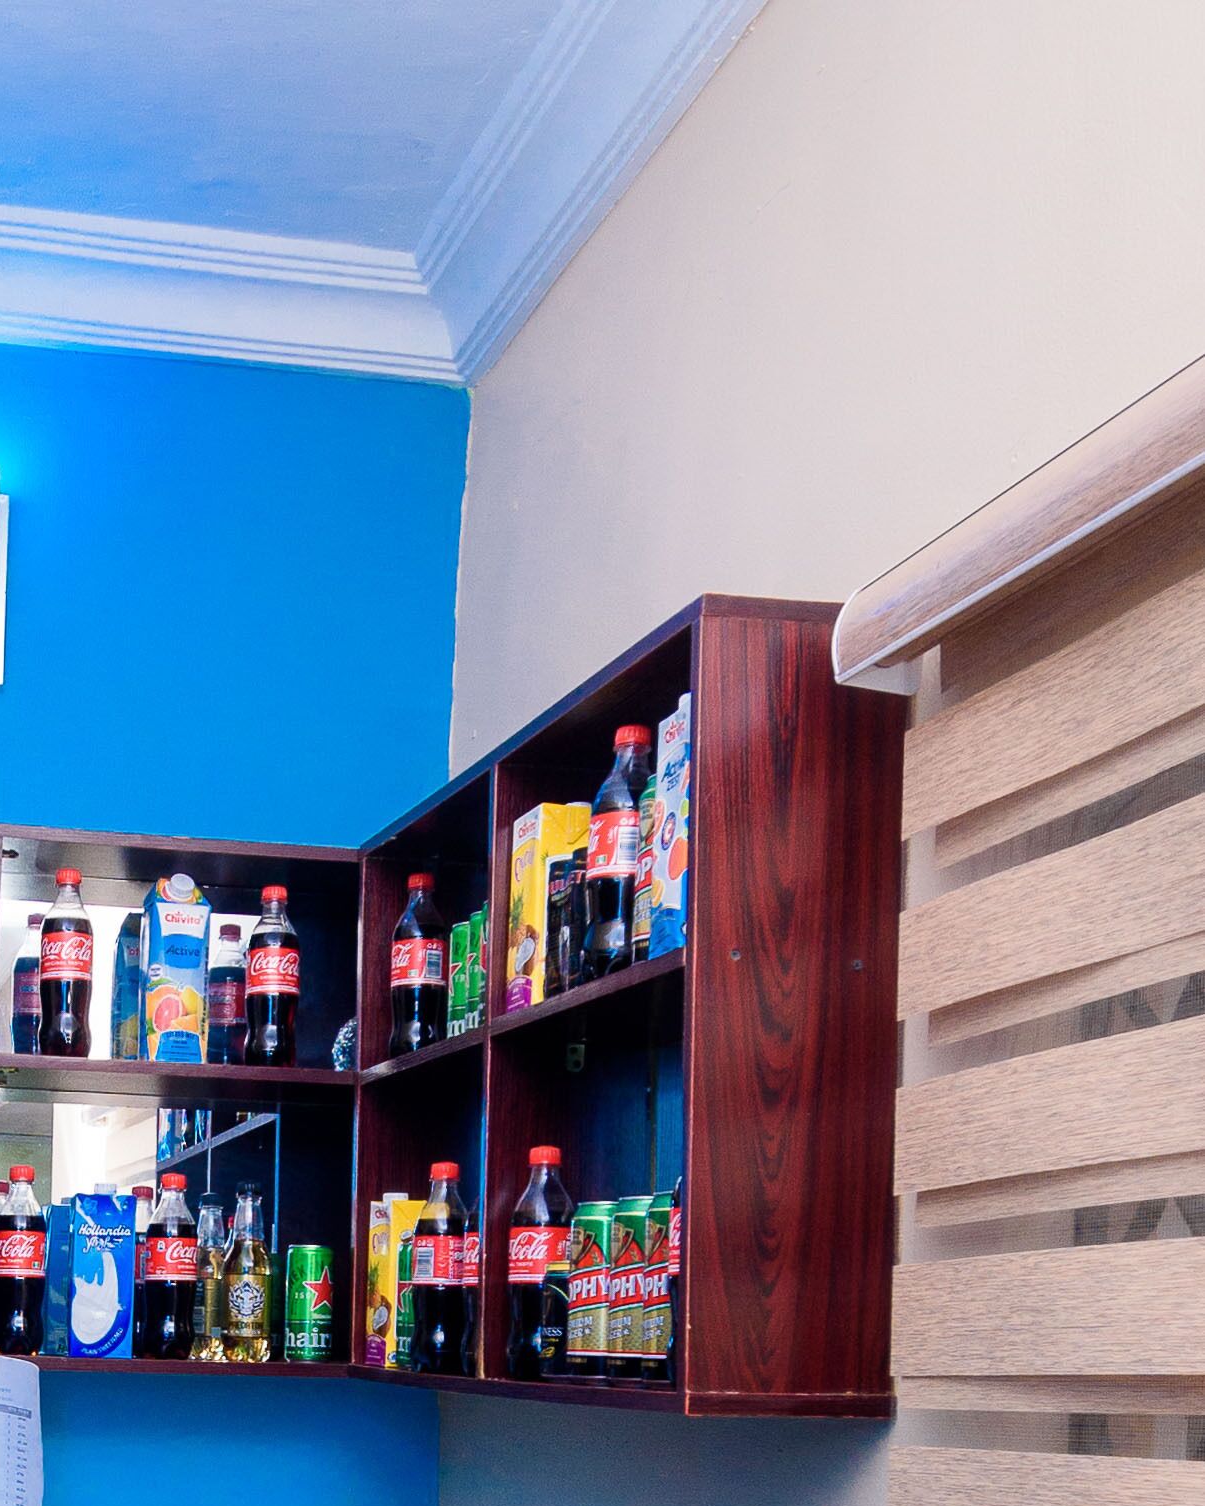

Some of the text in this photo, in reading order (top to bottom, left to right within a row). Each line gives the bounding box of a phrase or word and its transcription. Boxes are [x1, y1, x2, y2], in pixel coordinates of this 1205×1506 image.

[164, 911, 201, 925] Chivita
[164, 944, 201, 958] Active
[78, 1223, 132, 1237] Hollandia
